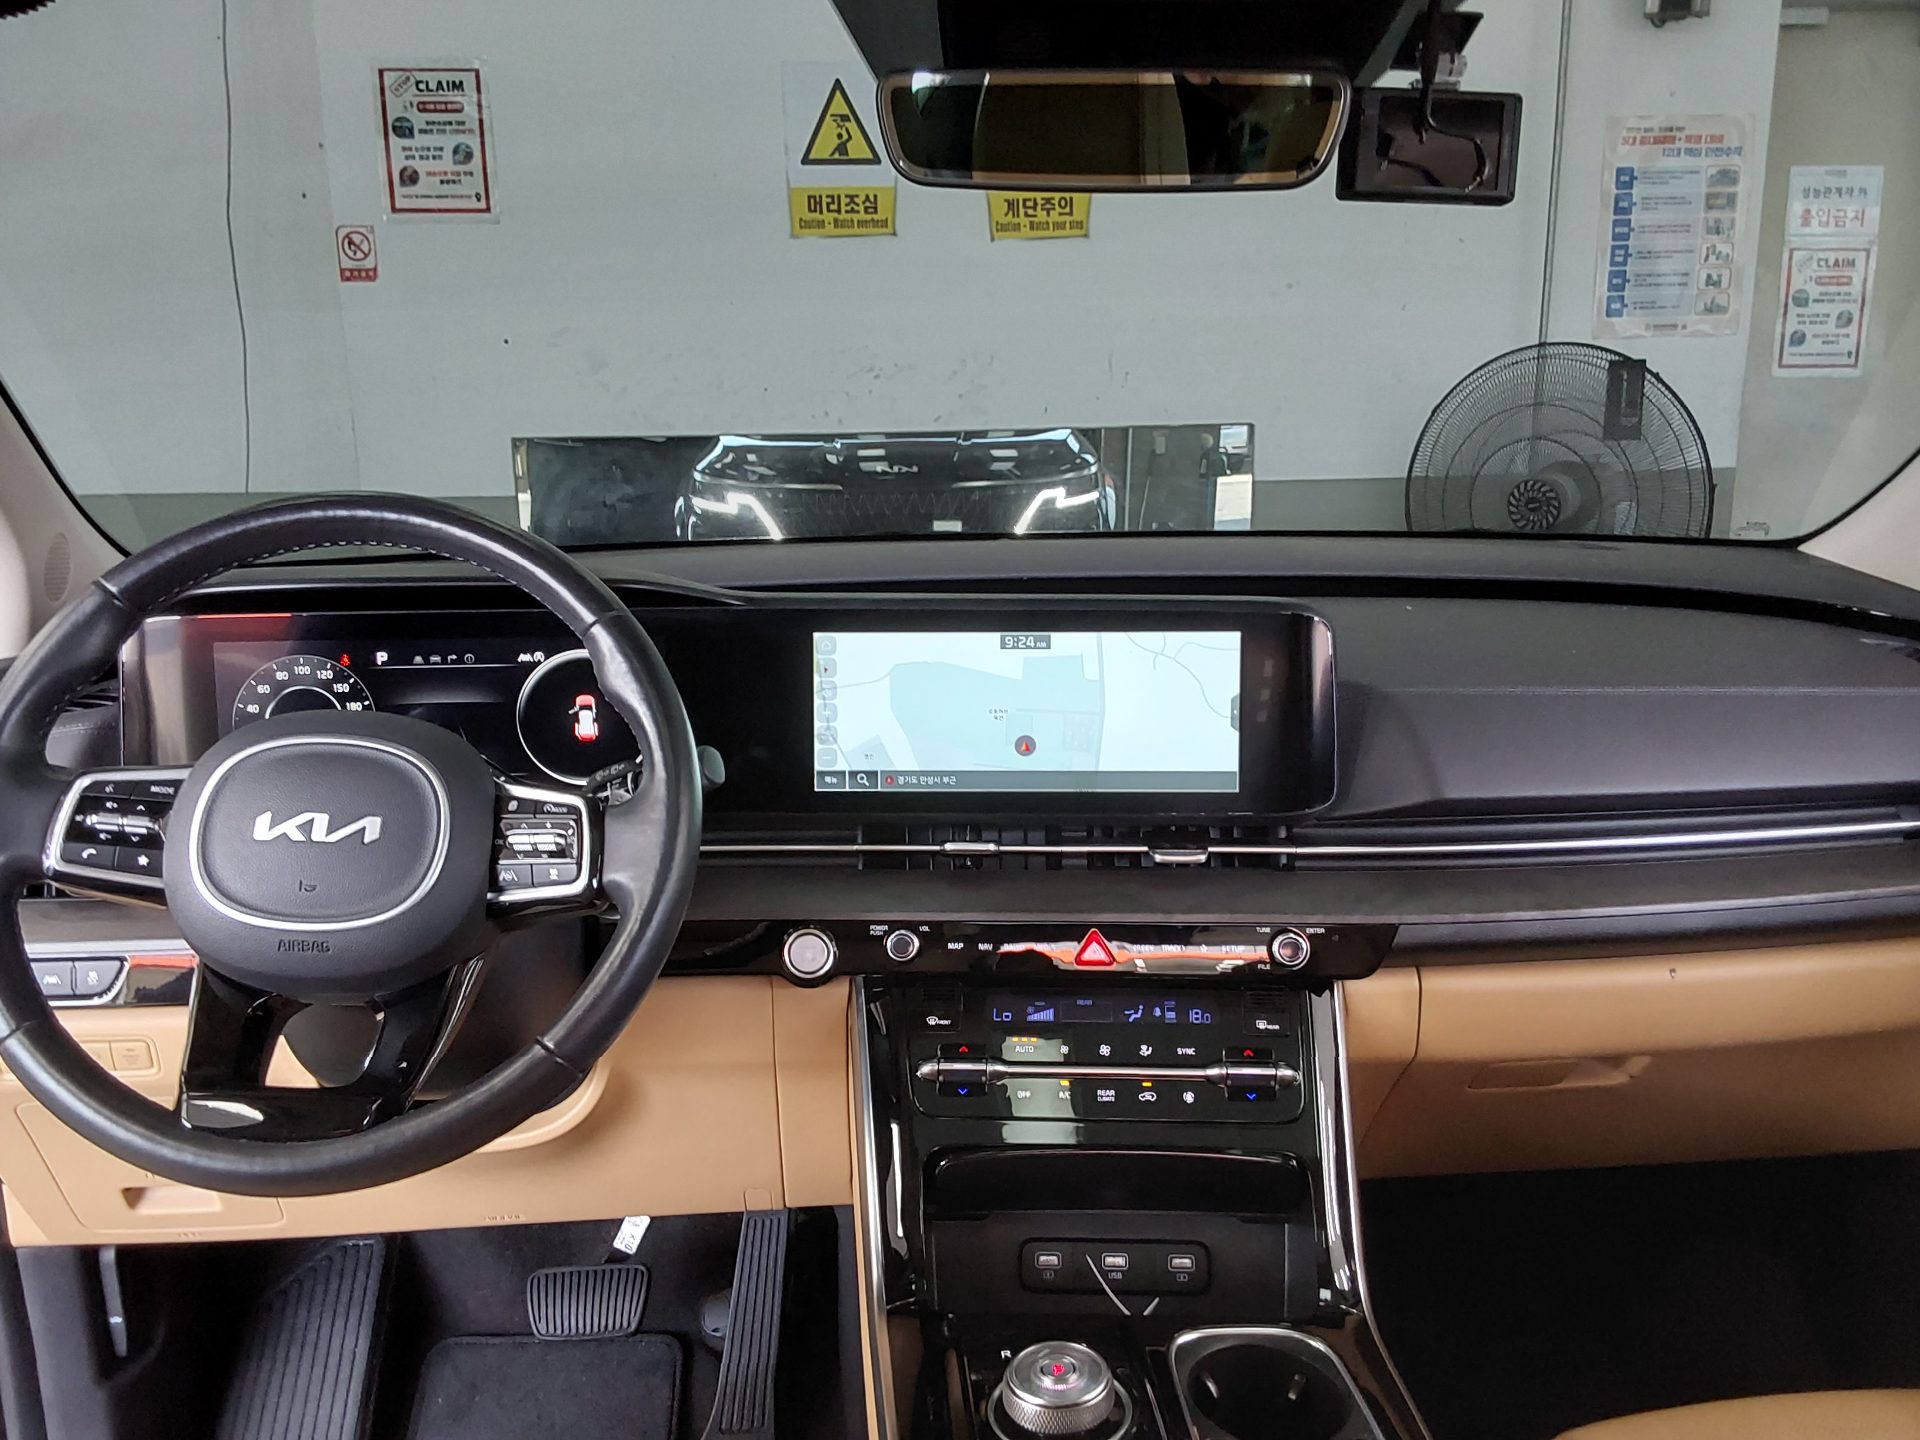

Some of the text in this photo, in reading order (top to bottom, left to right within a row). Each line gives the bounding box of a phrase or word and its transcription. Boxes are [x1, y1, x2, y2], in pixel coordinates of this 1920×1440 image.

[415, 79, 465, 93] CLAIM
[807, 194, 878, 215] 머리조심
[1003, 196, 1074, 219] 계단주의
[1800, 207, 1866, 228] 출입금지
[799, 217, 826, 230] Caution
[832, 217, 856, 230] Watch
[857, 217, 888, 230] overhead
[995, 220, 1021, 233] Caution
[1028, 219, 1051, 232] Watch
[1051, 219, 1068, 233] your
[1068, 219, 1084, 233] step
[1817, 257, 1856, 268] CLAIM
[1004, 635, 1035, 649] 9:24
[376, 651, 388, 664] P
[294, 666, 311, 675] 100
[317, 670, 333, 680] 120
[275, 671, 289, 681] 80
[257, 684, 271, 694] 60
[333, 683, 350, 693] 150
[246, 704, 260, 713] 40
[346, 701, 363, 712] 180
[897, 775, 957, 785] 경기도 안성시 부근
[277, 938, 331, 955] AIRBAG
[947, 942, 964, 950] MAP
[978, 943, 993, 951] NAV
[1258, 963, 1271, 971] FILE
[993, 1007, 1012, 1021] Lo
[1015, 1045, 1034, 1053] AUTO
[1177, 1047, 1196, 1055] SYNC
[1017, 1090, 1032, 1099] OFF
[1058, 1090, 1071, 1099] A/C
[1108, 1272, 1123, 1280] USB
[1000, 1349, 1012, 1359] R
[1052, 1362, 1065, 1376] P
